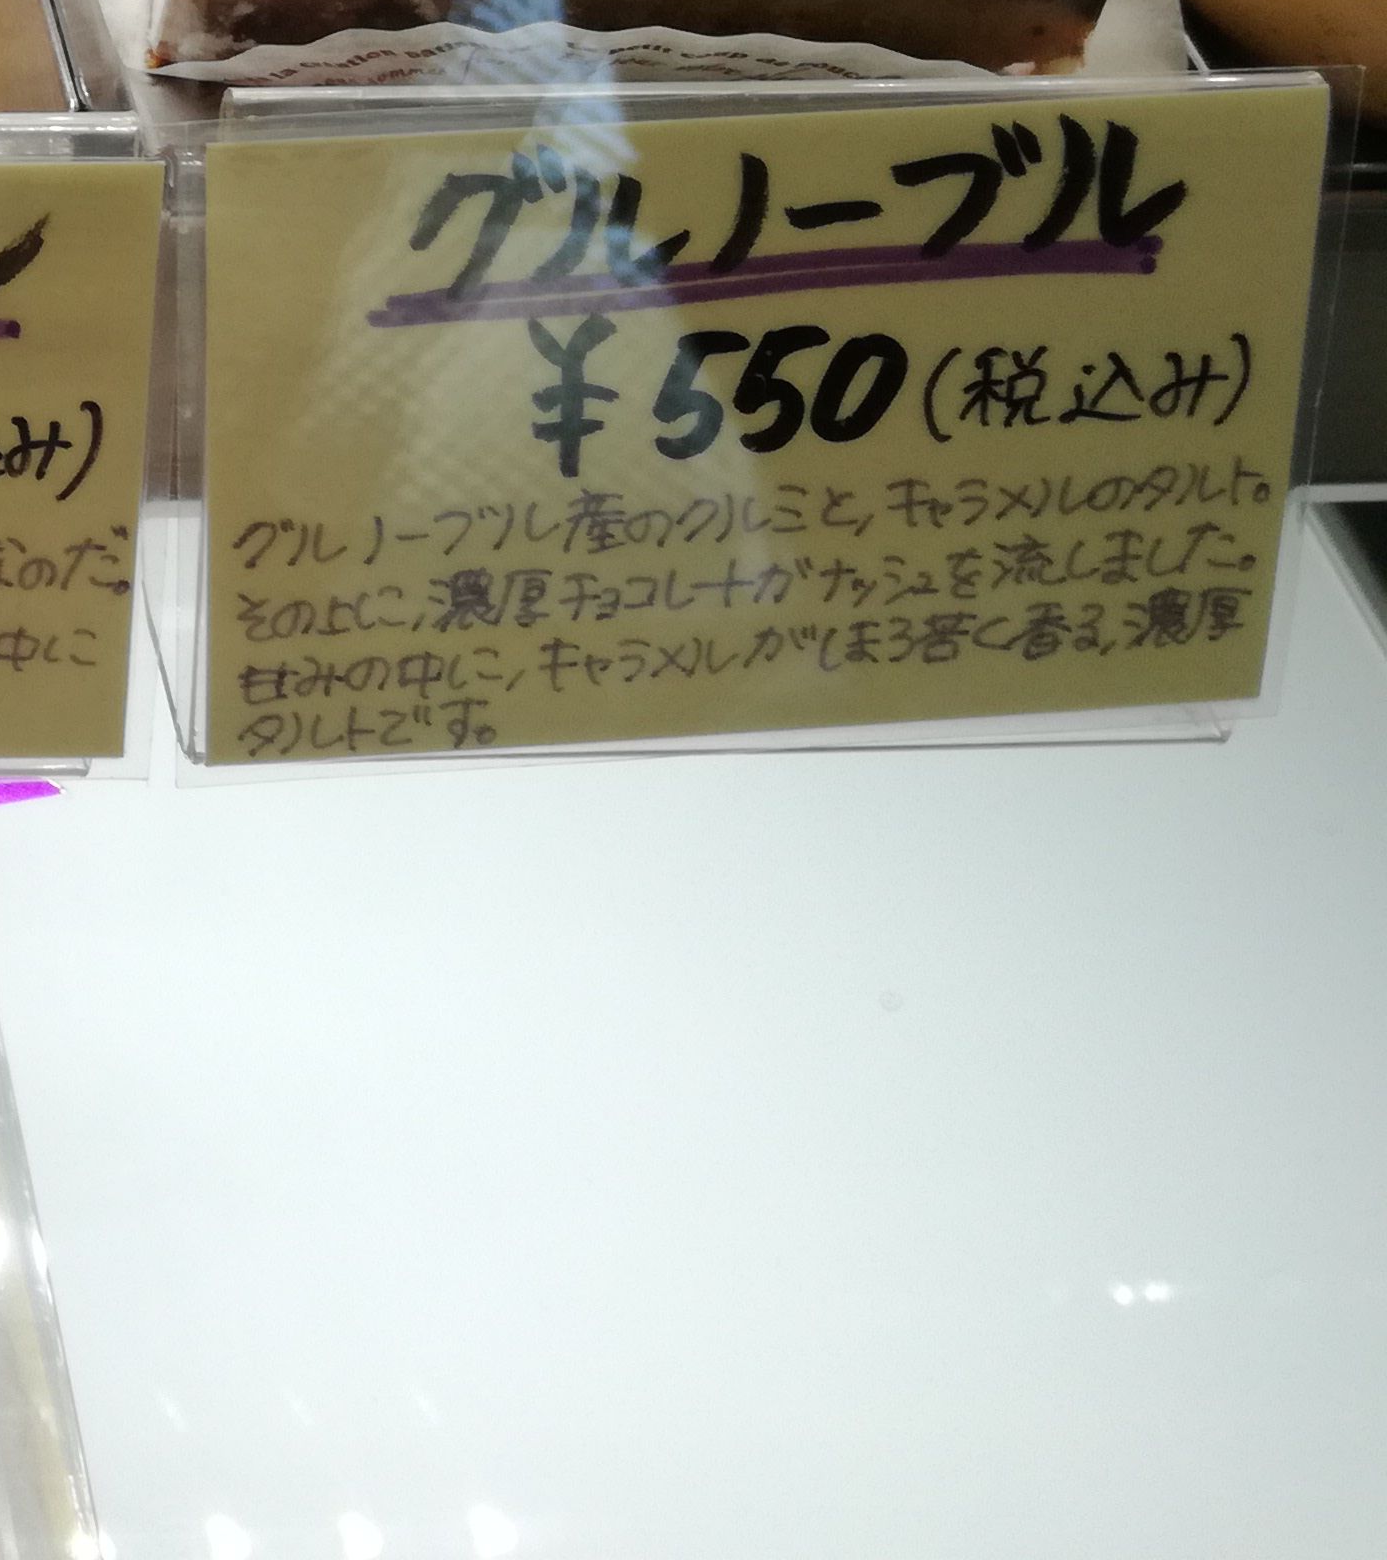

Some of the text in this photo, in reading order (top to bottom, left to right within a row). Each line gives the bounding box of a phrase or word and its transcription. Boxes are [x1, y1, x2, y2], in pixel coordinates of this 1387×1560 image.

[409, 114, 1189, 301] グルノーブル
